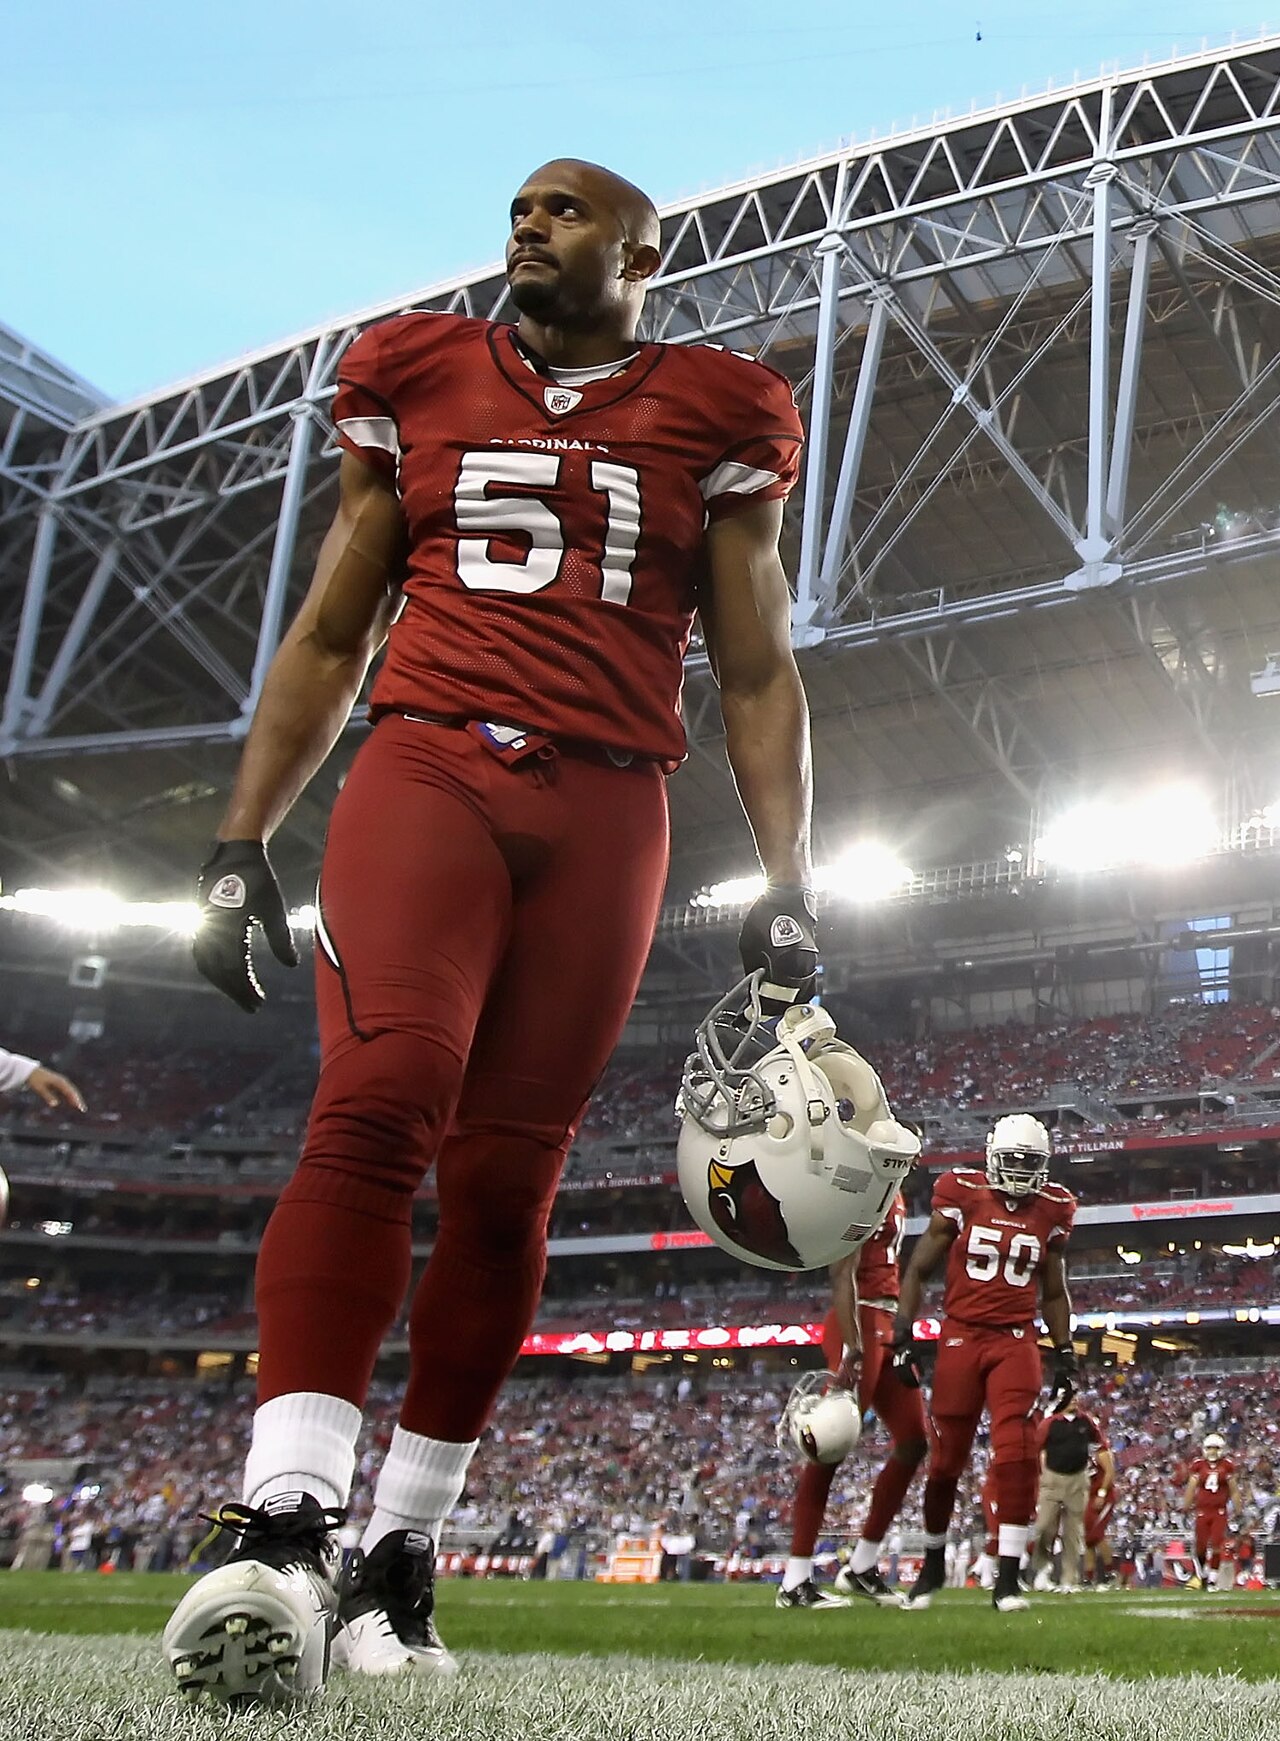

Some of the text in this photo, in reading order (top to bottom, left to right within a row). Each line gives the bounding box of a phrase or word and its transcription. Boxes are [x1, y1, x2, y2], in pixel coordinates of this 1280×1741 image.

[454, 451, 641, 606] 51
[1054, 1141, 1124, 1154] PAT TILLMAN
[965, 1225, 1041, 1287] 50
[1205, 1471, 1219, 1493] 4
